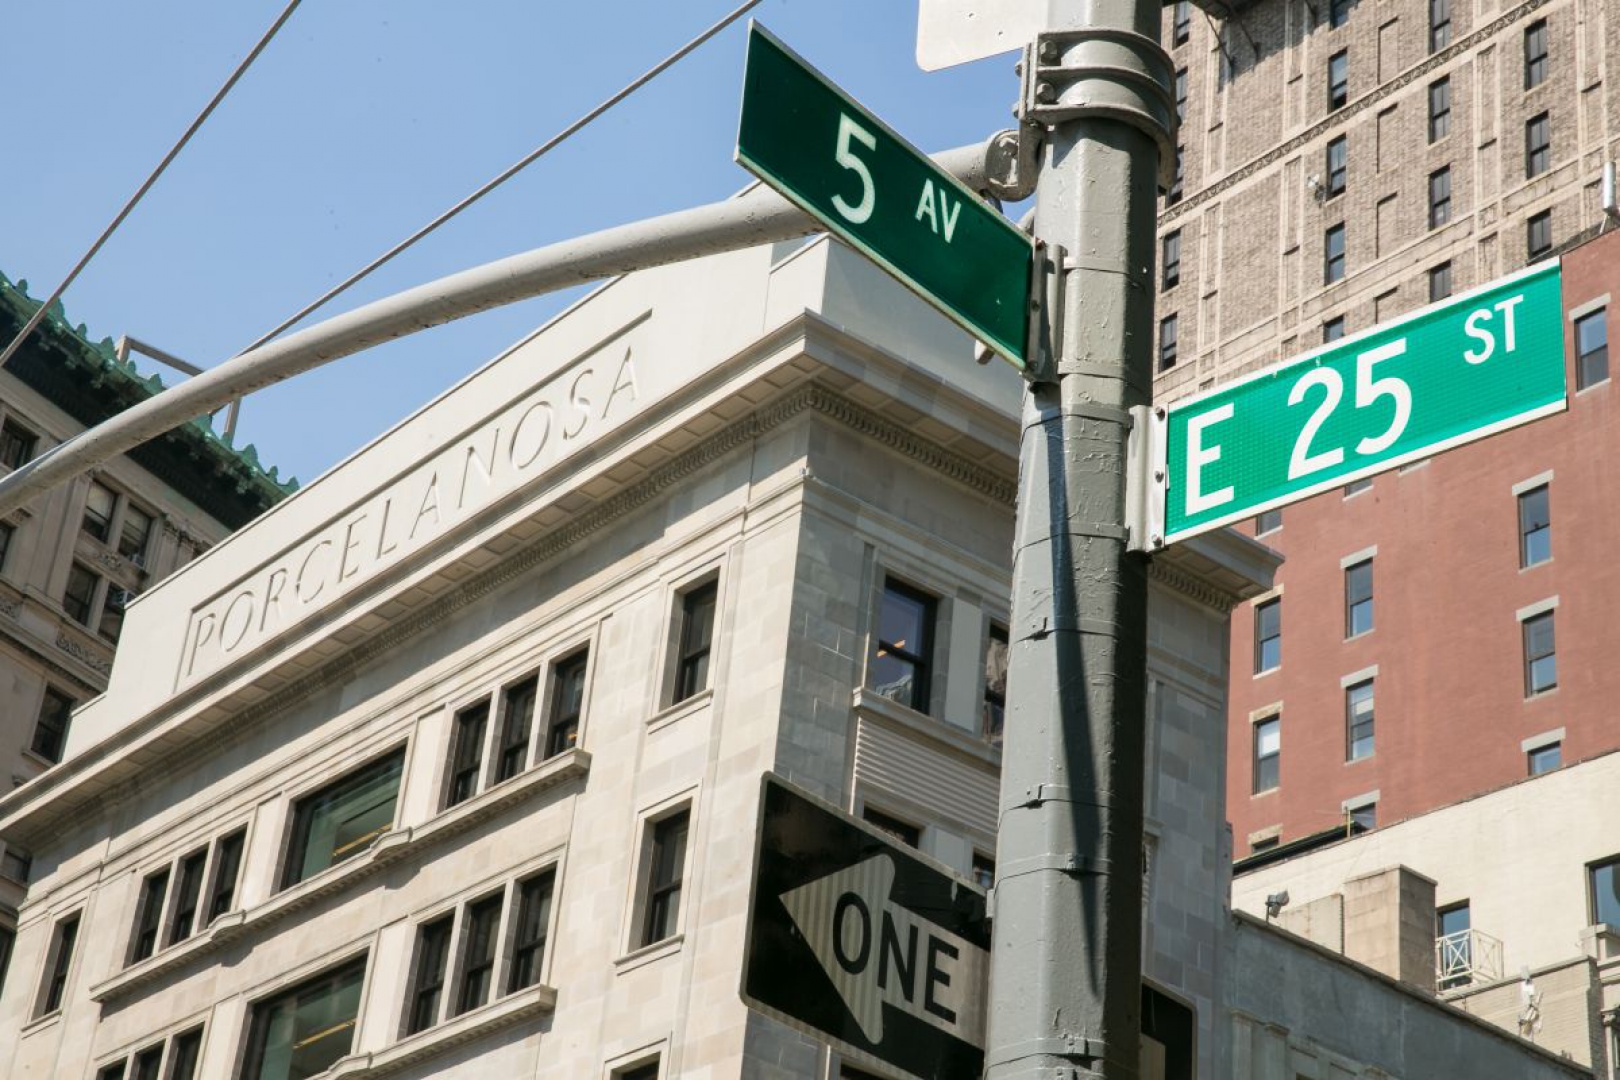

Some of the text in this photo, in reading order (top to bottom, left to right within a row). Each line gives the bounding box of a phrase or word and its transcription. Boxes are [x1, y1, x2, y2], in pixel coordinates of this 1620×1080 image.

[831, 112, 961, 243] 5 AV
[1185, 294, 1523, 516] E 25 ST
[187, 346, 640, 677] PORCELANOSA
[833, 892, 959, 1025] ONE
